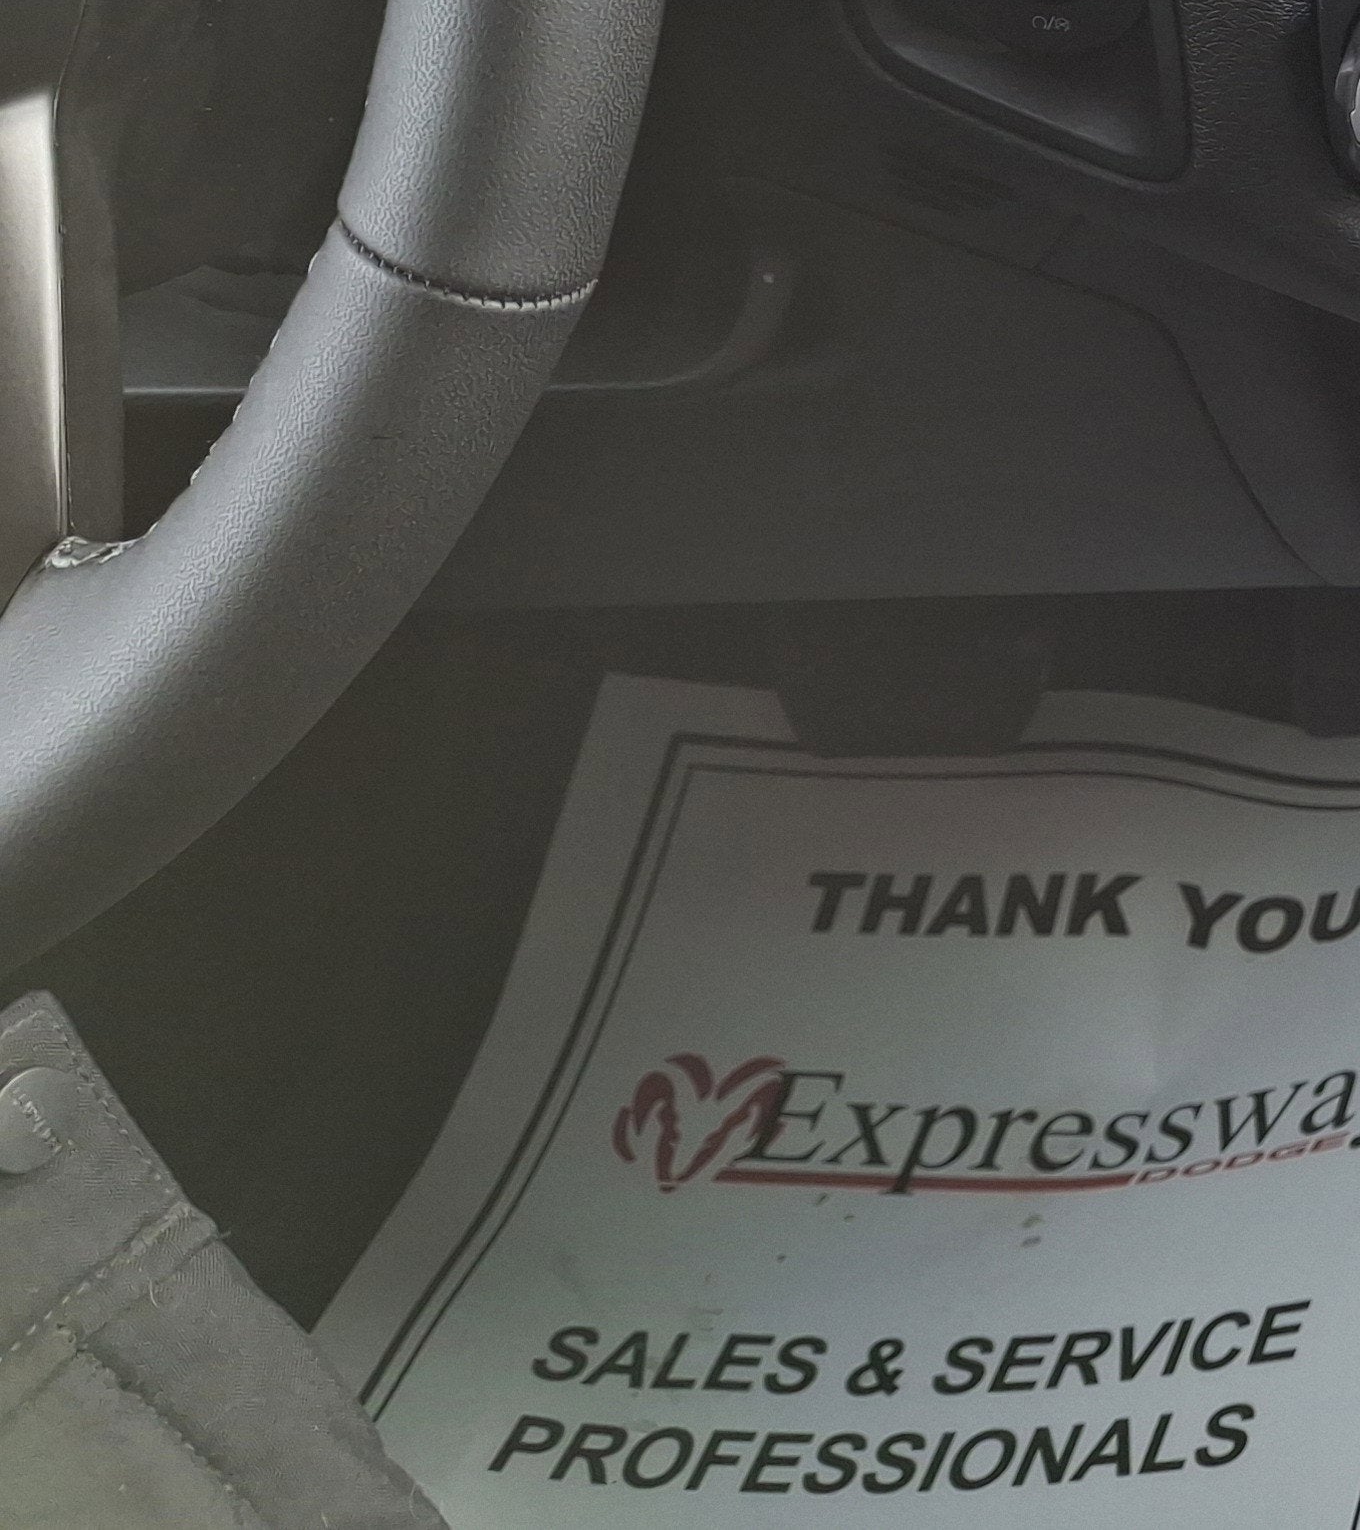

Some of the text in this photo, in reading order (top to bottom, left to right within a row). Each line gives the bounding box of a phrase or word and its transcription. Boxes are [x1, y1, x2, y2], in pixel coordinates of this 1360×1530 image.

[808, 874, 1142, 936] THANK
[1133, 1131, 1352, 1183] DODGE
[532, 1300, 1310, 1396] SALES & SERVICE
[490, 1403, 1256, 1495] PROFESSIONALS
